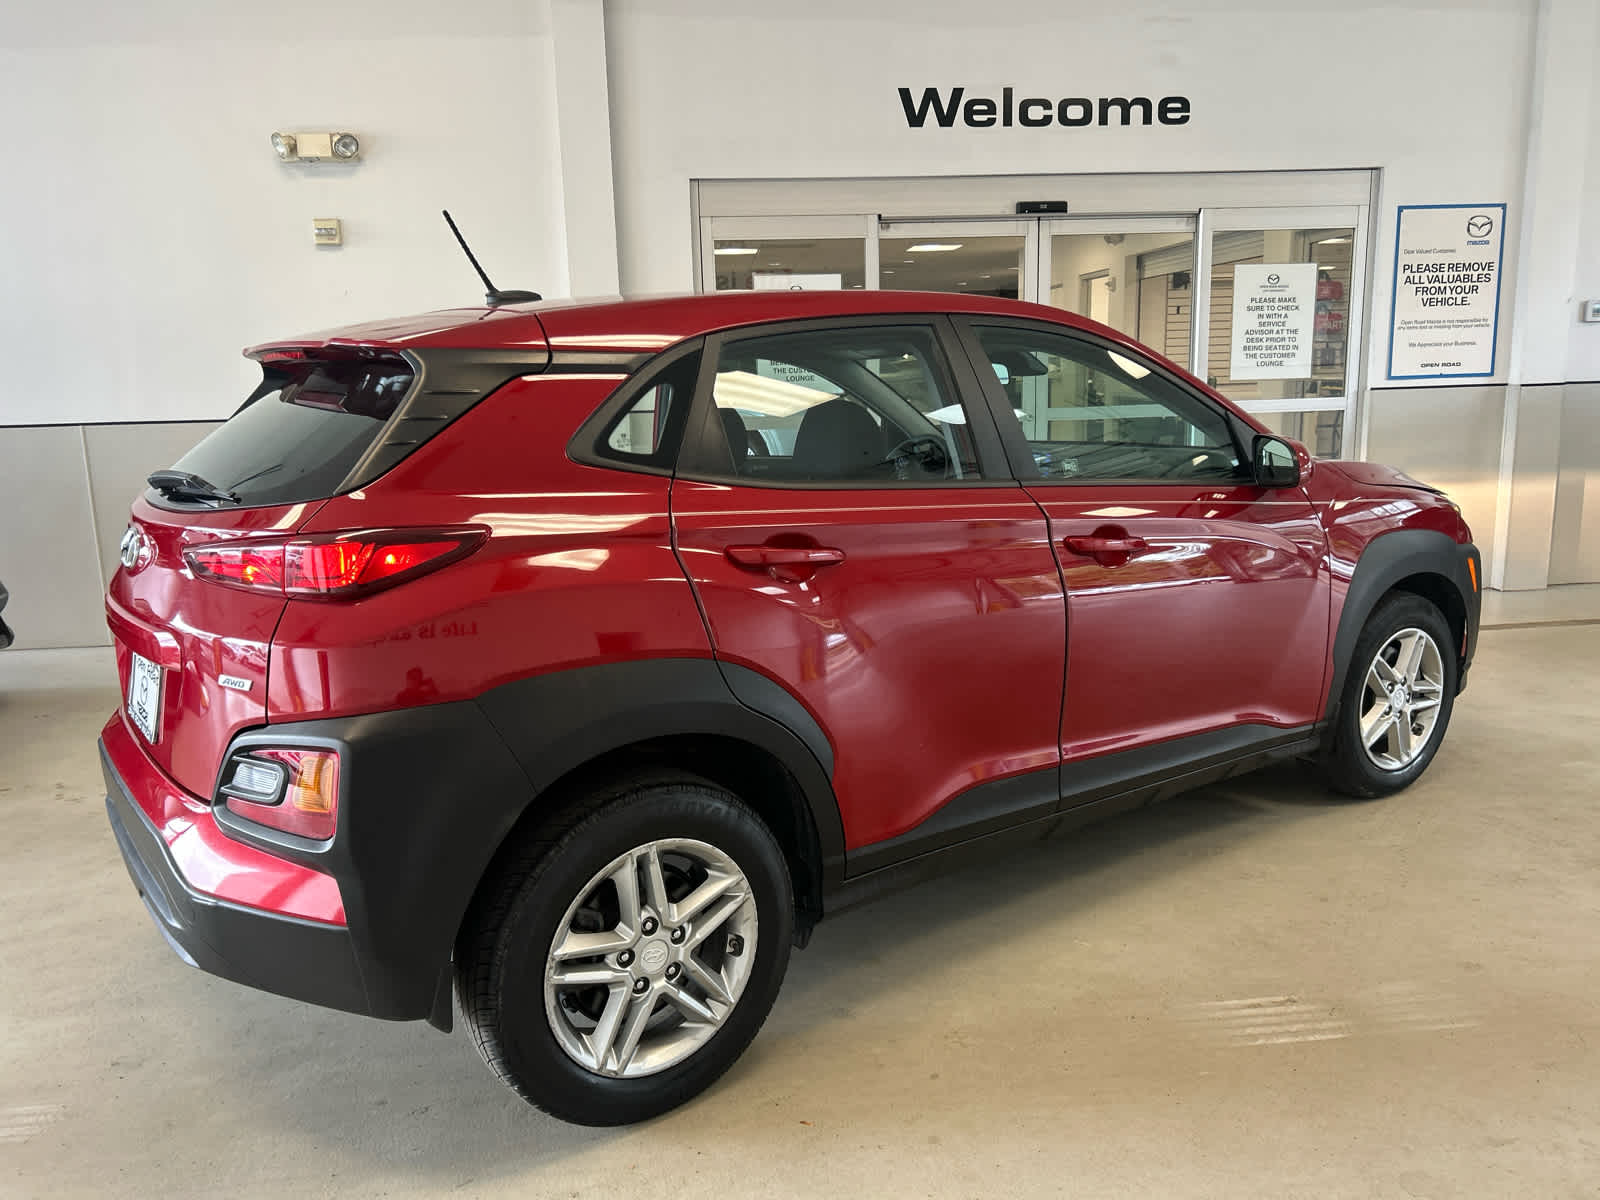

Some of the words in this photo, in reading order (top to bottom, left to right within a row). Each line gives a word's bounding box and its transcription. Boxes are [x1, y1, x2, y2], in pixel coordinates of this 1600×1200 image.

[898, 87, 1191, 128] Welcome
[1403, 263, 1446, 274] PLEASE
[1447, 261, 1495, 272] REMOVE
[1404, 275, 1425, 285] ALL
[1426, 273, 1492, 284] VALUABLES
[1415, 286, 1448, 296] FROM
[1448, 284, 1479, 295] YOUR
[1277, 296, 1297, 304] MAKE
[1421, 296, 1471, 307] VEHICLE.
[1277, 304, 1300, 312] CHECK
[1258, 320, 1287, 328] SERVICE
[1265, 344, 1291, 352] SEATED
[222, 678, 245, 688] AWD
